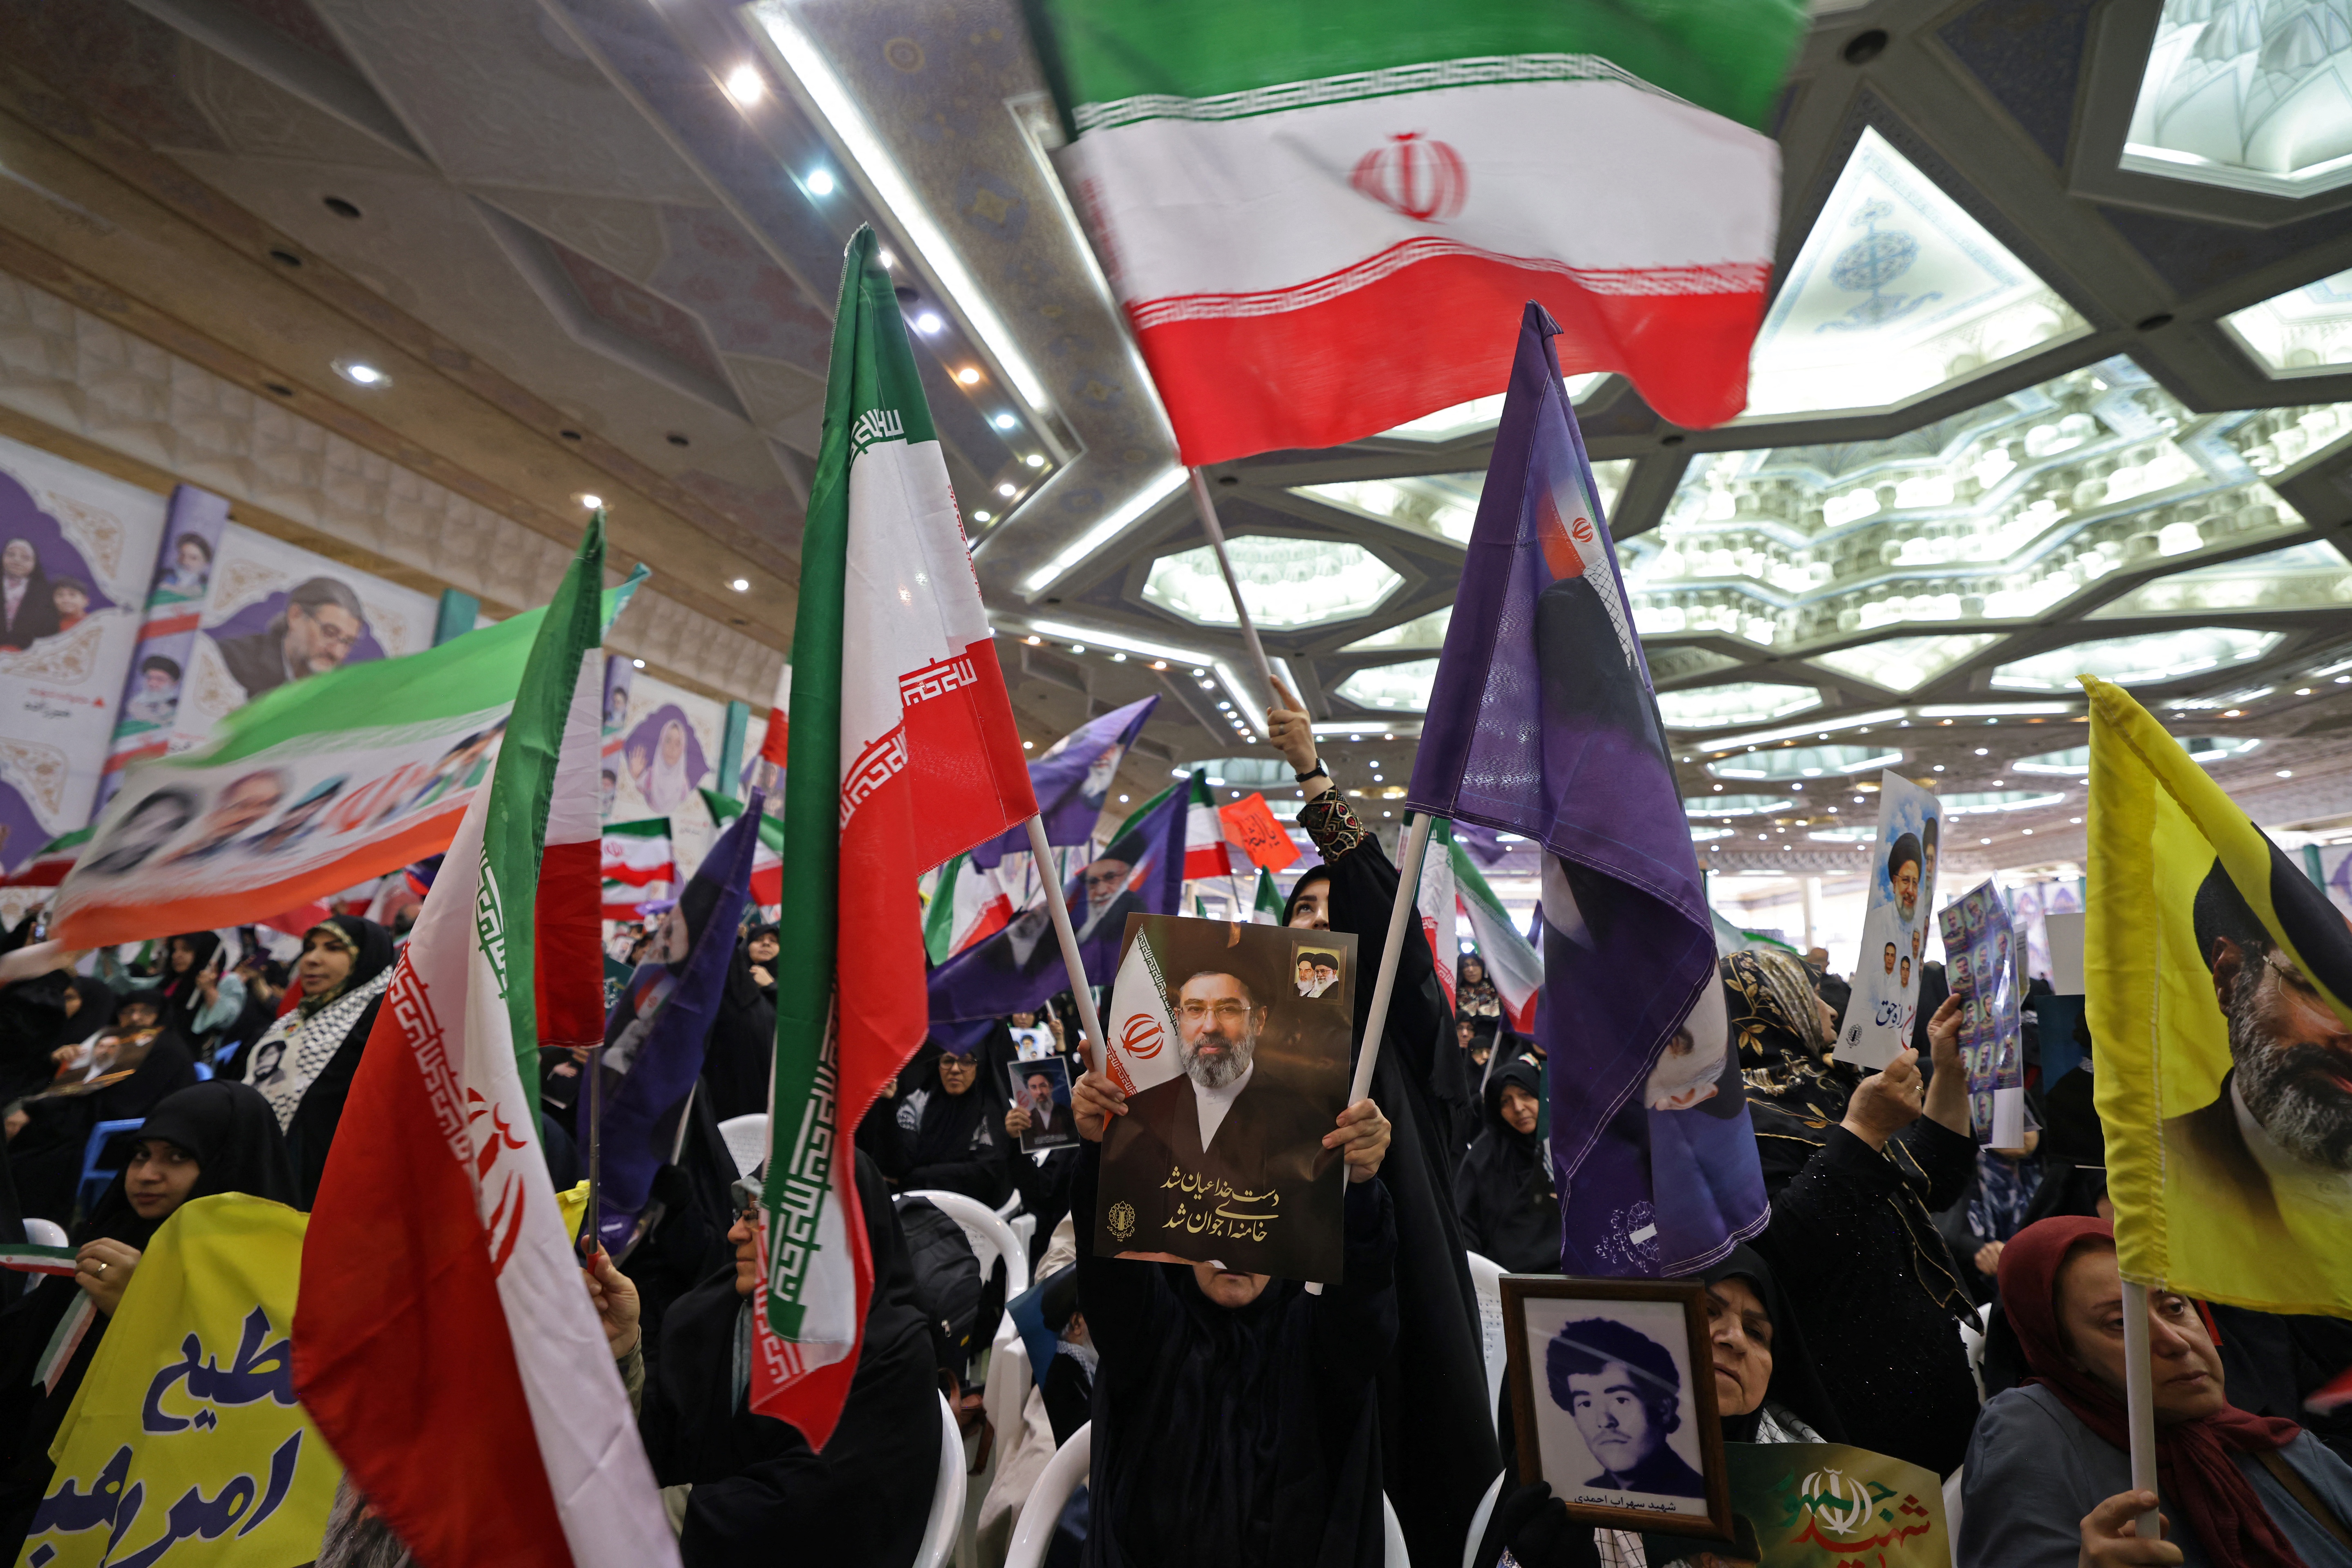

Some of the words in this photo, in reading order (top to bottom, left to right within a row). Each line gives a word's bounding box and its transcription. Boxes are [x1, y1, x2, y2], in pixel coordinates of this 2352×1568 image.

[1160, 1166, 1182, 1189] شد
[1180, 1171, 1214, 1201] عیان
[1214, 1177, 1233, 1198] خدا
[1232, 1188, 1279, 1207] دست
[1162, 1203, 1186, 1228] شد
[1186, 1210, 1225, 1237] جوان
[1574, 1494, 1607, 1504] احمدی
[1610, 1496, 1645, 1510] سهراب
[1648, 1502, 1676, 1512] شهید
